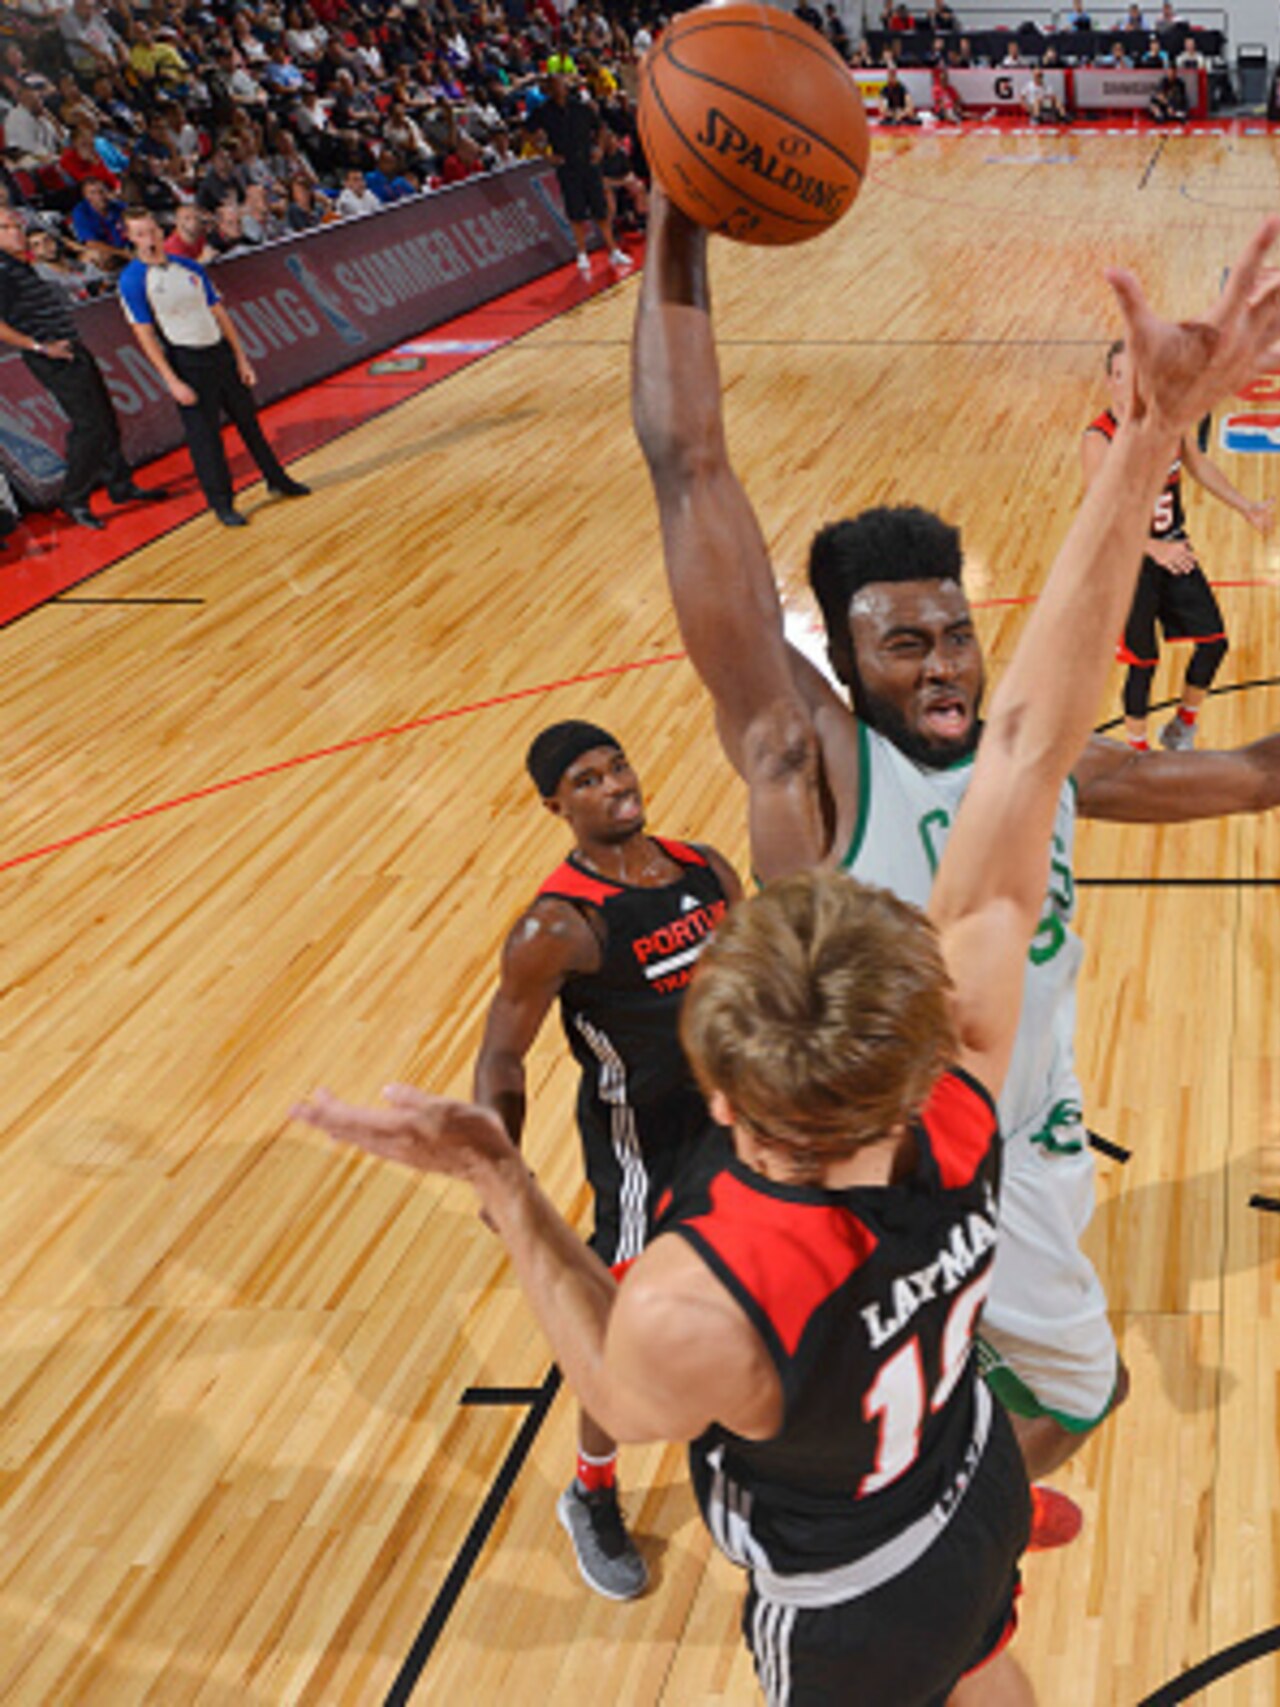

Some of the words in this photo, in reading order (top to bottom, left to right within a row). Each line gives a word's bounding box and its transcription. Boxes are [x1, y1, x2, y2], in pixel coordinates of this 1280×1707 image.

[697, 108, 849, 215] SPALDING
[96, 288, 319, 415] SAUNG
[334, 228, 471, 315] SUMMER
